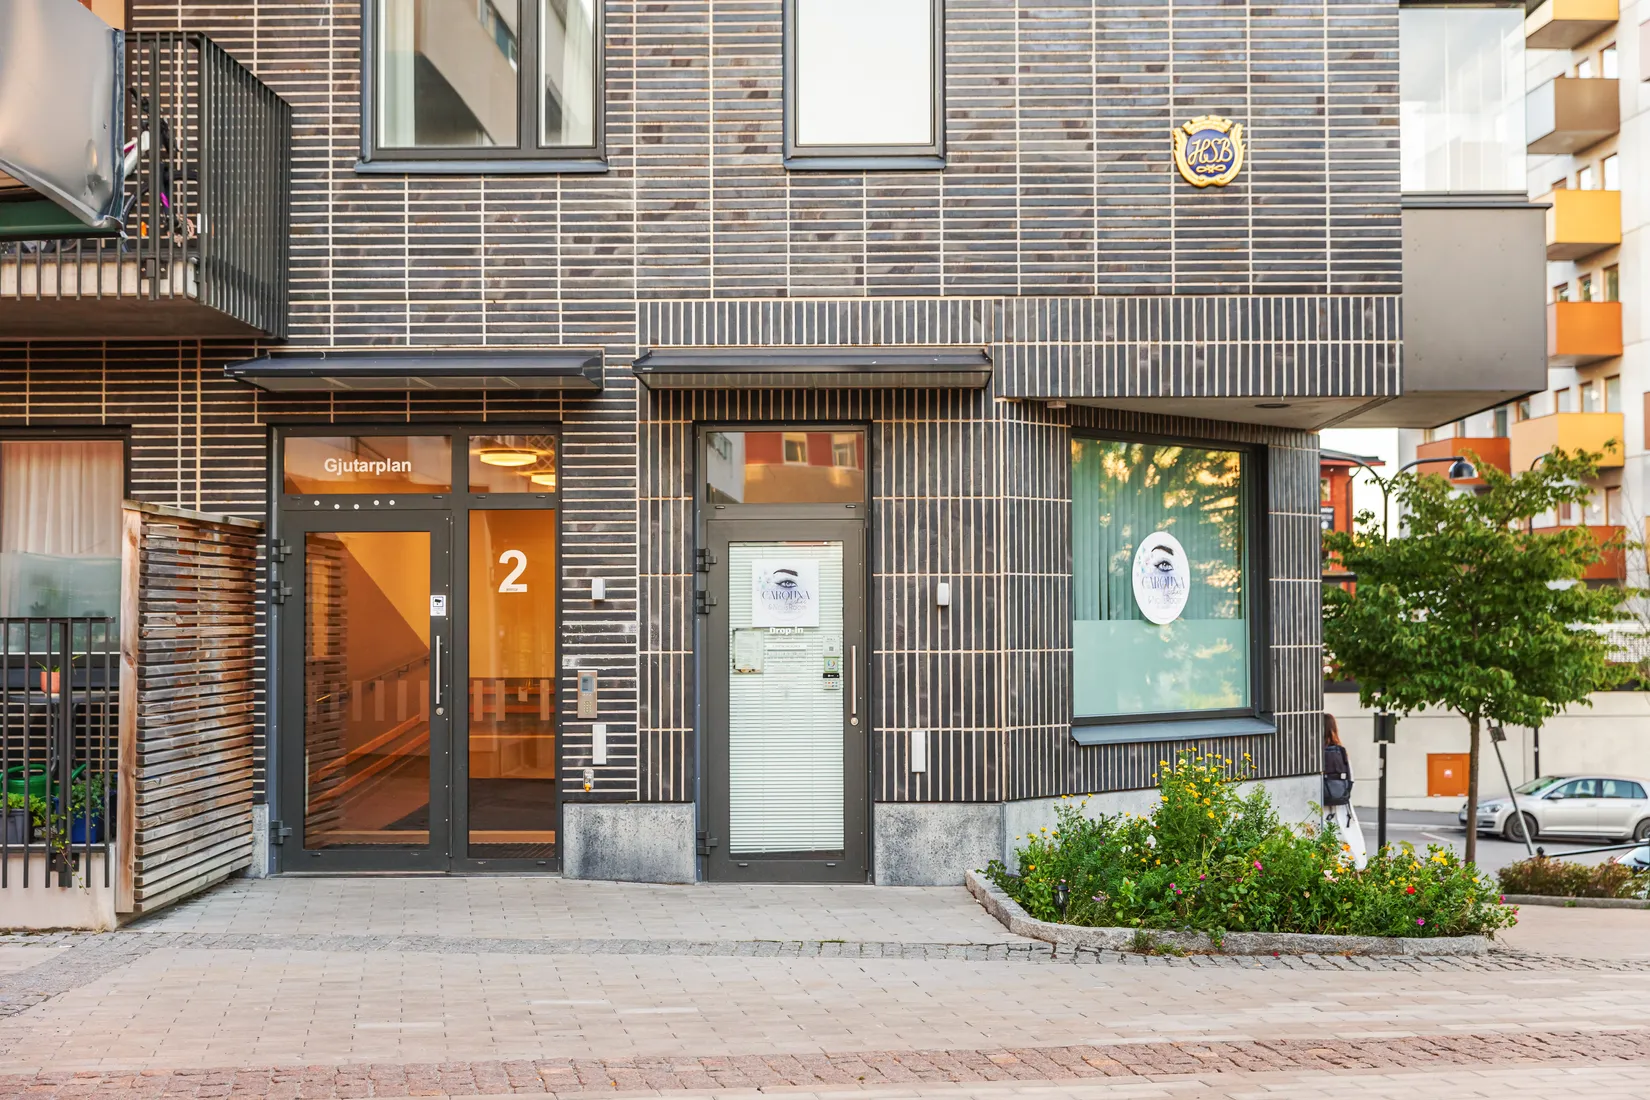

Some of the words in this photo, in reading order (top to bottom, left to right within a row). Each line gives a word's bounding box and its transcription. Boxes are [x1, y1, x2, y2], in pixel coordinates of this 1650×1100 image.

[1187, 137, 1233, 166] HSB
[324, 457, 412, 475] Gjutarplan
[498, 549, 528, 593] 2
